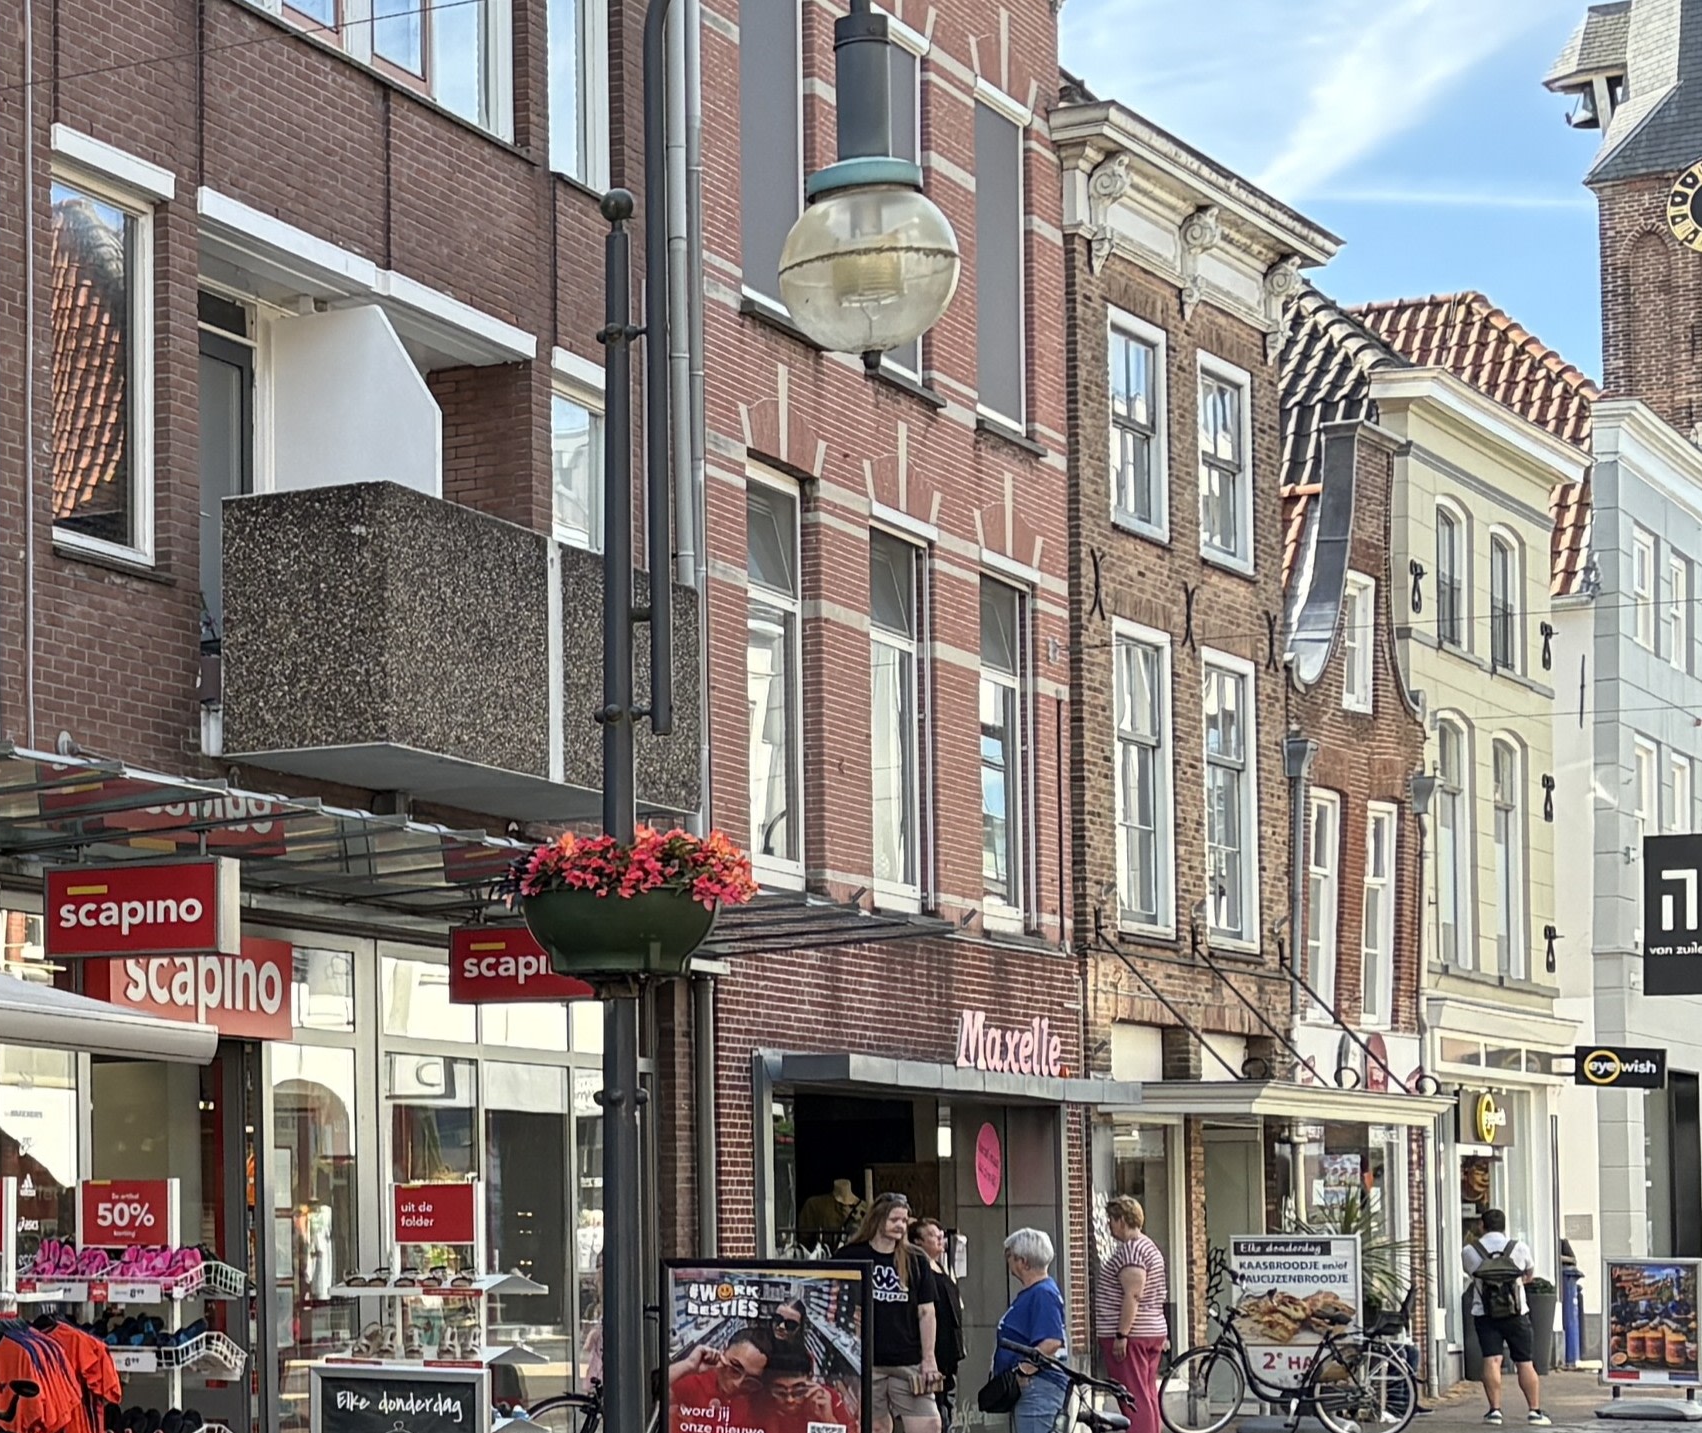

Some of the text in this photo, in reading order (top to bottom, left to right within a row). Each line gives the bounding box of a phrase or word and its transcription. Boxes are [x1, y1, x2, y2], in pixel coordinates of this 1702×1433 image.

[59, 897, 203, 936] scapino
[463, 954, 553, 985] scapi
[125, 957, 283, 1025] scapino
[956, 1009, 1061, 1077] Maxelle
[97, 1202, 155, 1227] 50%
[400, 1201, 433, 1213] uit de
[400, 1215, 434, 1228] folder
[1240, 1242, 1322, 1255] Elke donderdag
[1239, 1261, 1320, 1270] KAASBROODJE
[1244, 1274, 1349, 1284] AUCIJZENBROODJE
[687, 1300, 759, 1318] BESTIES
[336, 1390, 463, 1422] Elke donderdag
[680, 1405, 730, 1422] word jij
[680, 1422, 712, 1433] onze
